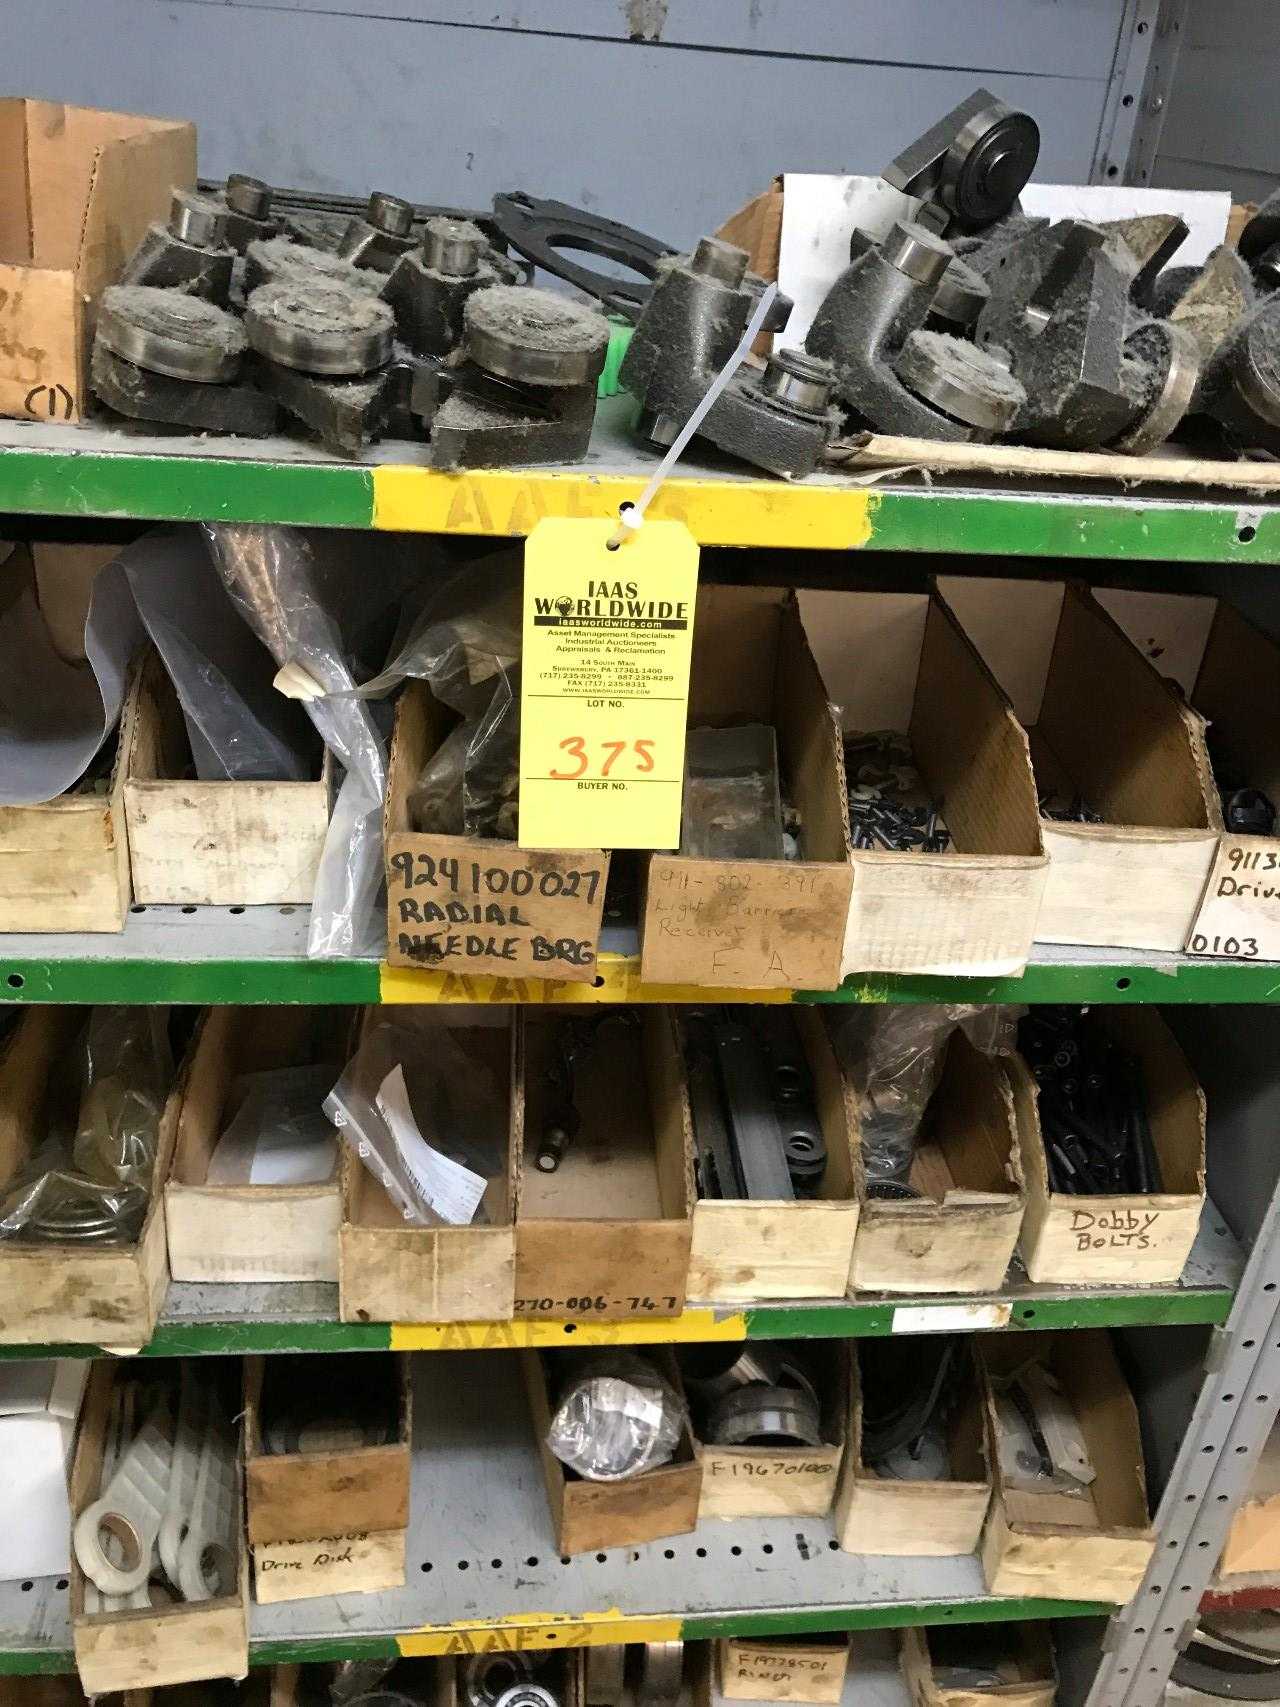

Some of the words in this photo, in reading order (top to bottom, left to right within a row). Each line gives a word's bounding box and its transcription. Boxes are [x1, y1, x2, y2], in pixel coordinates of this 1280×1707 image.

[588, 581, 638, 599] IAAS
[558, 618, 662, 629] iaasworldwide.com
[573, 630, 629, 639] Management
[556, 645, 601, 653] Appraisals
[606, 639, 657, 647] Auctioneers
[587, 700, 605, 708] LOT
[608, 700, 625, 708] NO.
[549, 736, 656, 780] 375
[577, 782, 608, 790] BUYER
[611, 783, 628, 791] NO.
[1228, 848, 1280, 871] 9113
[398, 897, 530, 926] RADIAL
[399, 932, 521, 961] NEEDLE
[530, 935, 595, 966] BRG
[1069, 1208, 1160, 1235] Dobby
